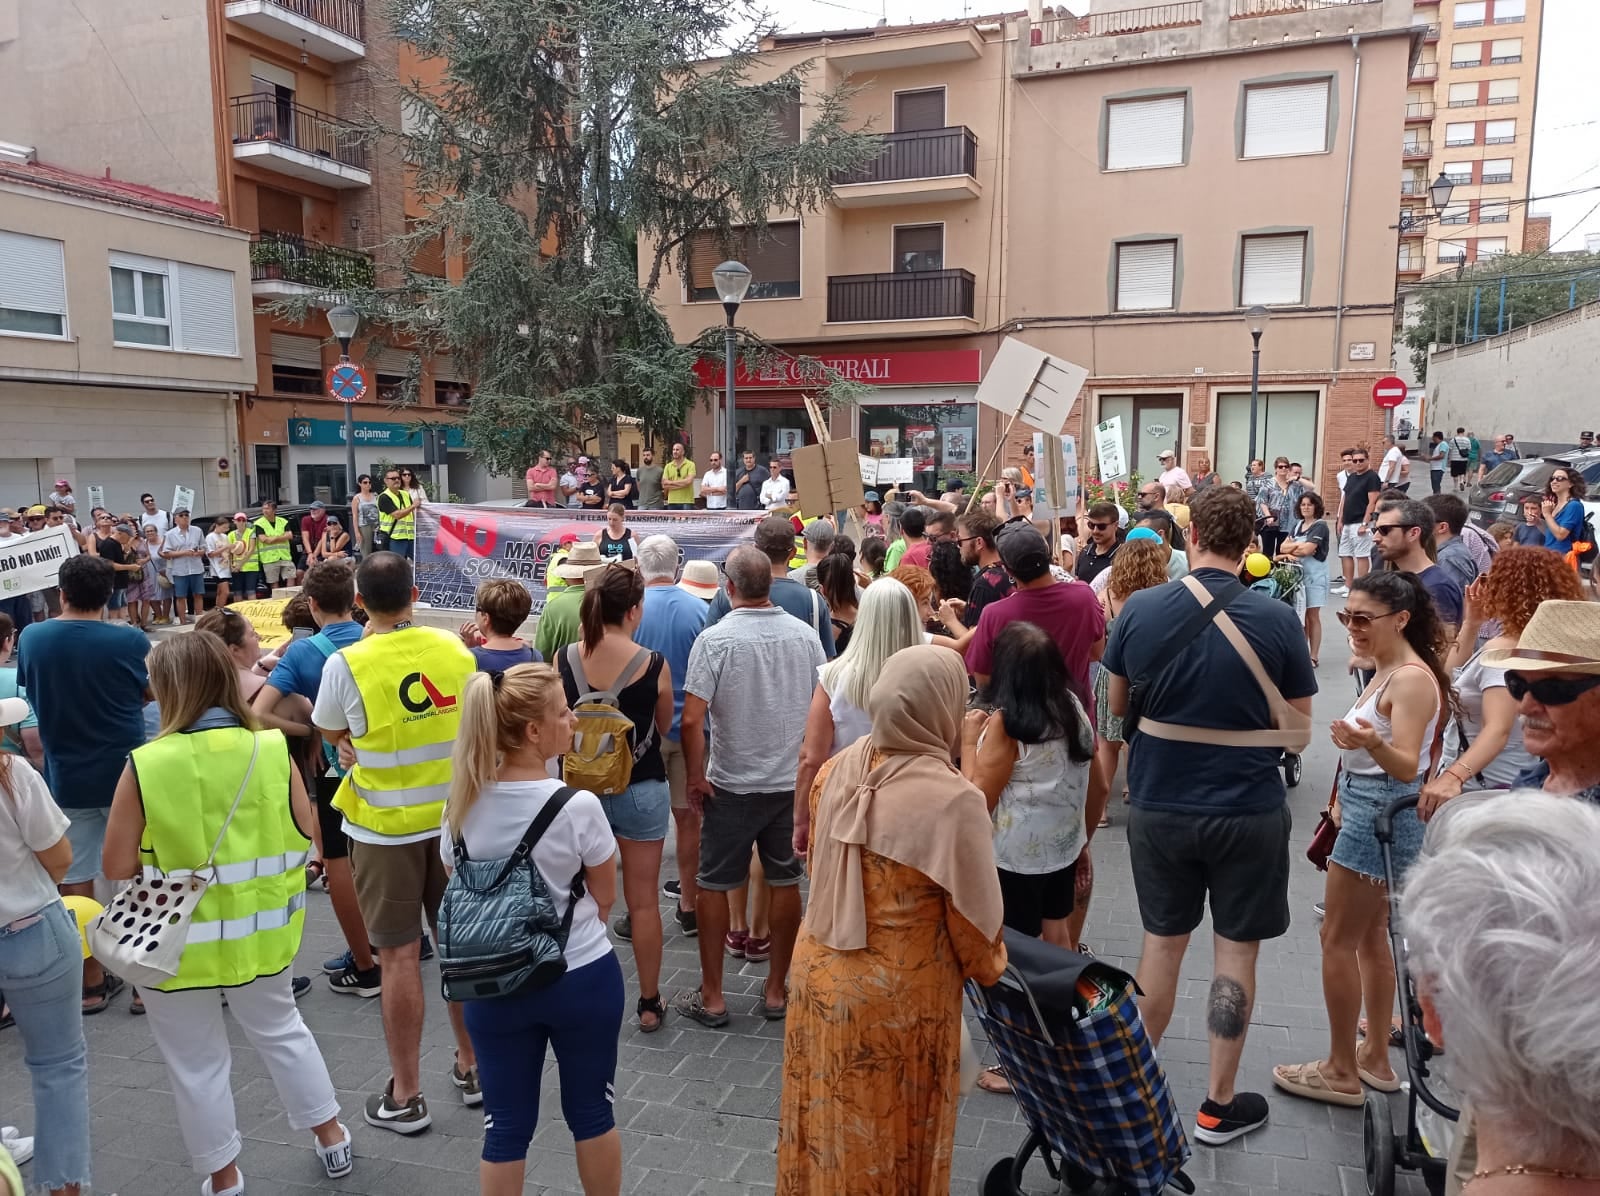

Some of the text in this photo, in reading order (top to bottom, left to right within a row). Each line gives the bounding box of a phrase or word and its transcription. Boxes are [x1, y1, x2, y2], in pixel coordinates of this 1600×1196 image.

[790, 358, 892, 380] GNERALI
[353, 426, 392, 441] cajamar
[587, 514, 608, 522] LLAM
[626, 515, 669, 524] RANSICIÓN
[433, 514, 498, 558] NO
[18, 552, 34, 568] NO
[34, 544, 63, 564] AIXÍ!!
[504, 540, 561, 561] MAC
[463, 557, 547, 580] SOLARE
[431, 591, 449, 605] SÍ
[451, 594, 463, 606] A
